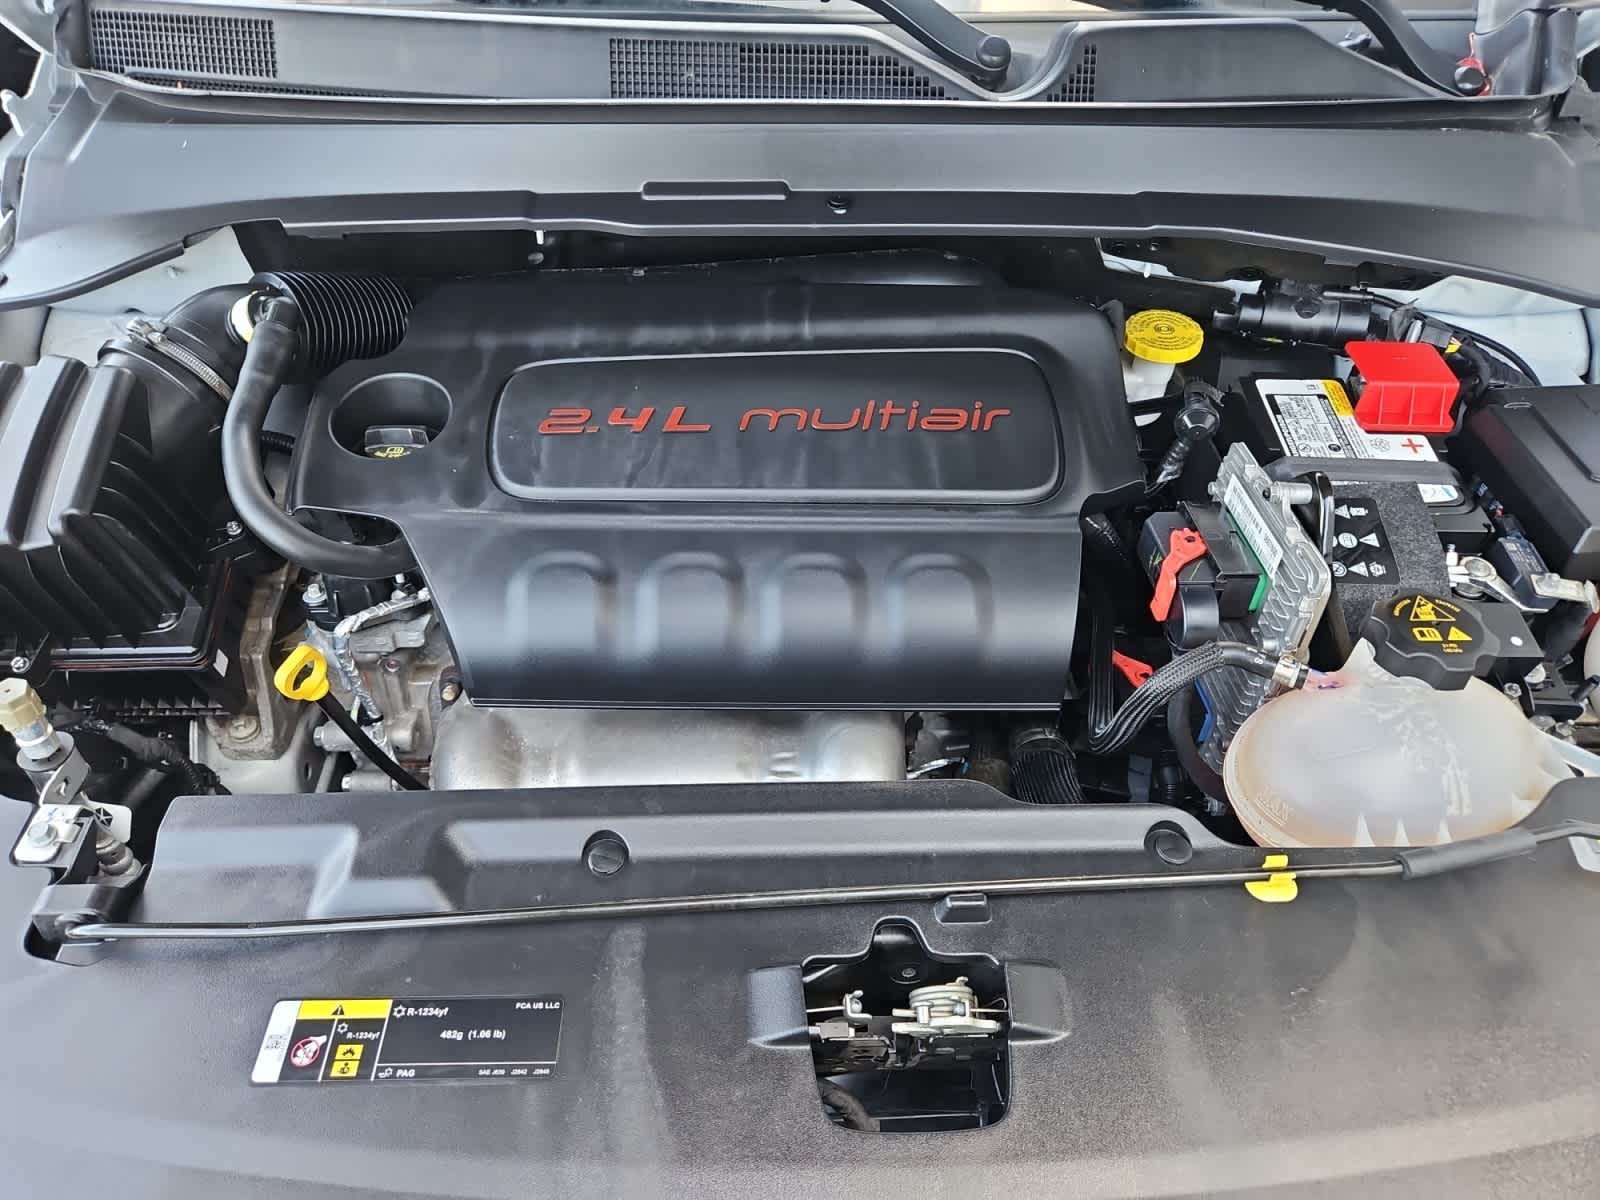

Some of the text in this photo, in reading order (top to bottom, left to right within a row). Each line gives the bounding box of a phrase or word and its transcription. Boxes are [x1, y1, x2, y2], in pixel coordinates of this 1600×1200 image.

[738, 399, 1012, 433] multiair
[515, 1002, 560, 1010] FCA US LLC
[406, 1006, 449, 1018] R-1234yf
[346, 1030, 381, 1041] R-1234yf
[439, 1029, 507, 1041] 482g (1.06 lb)
[395, 1068, 416, 1078] PAG
